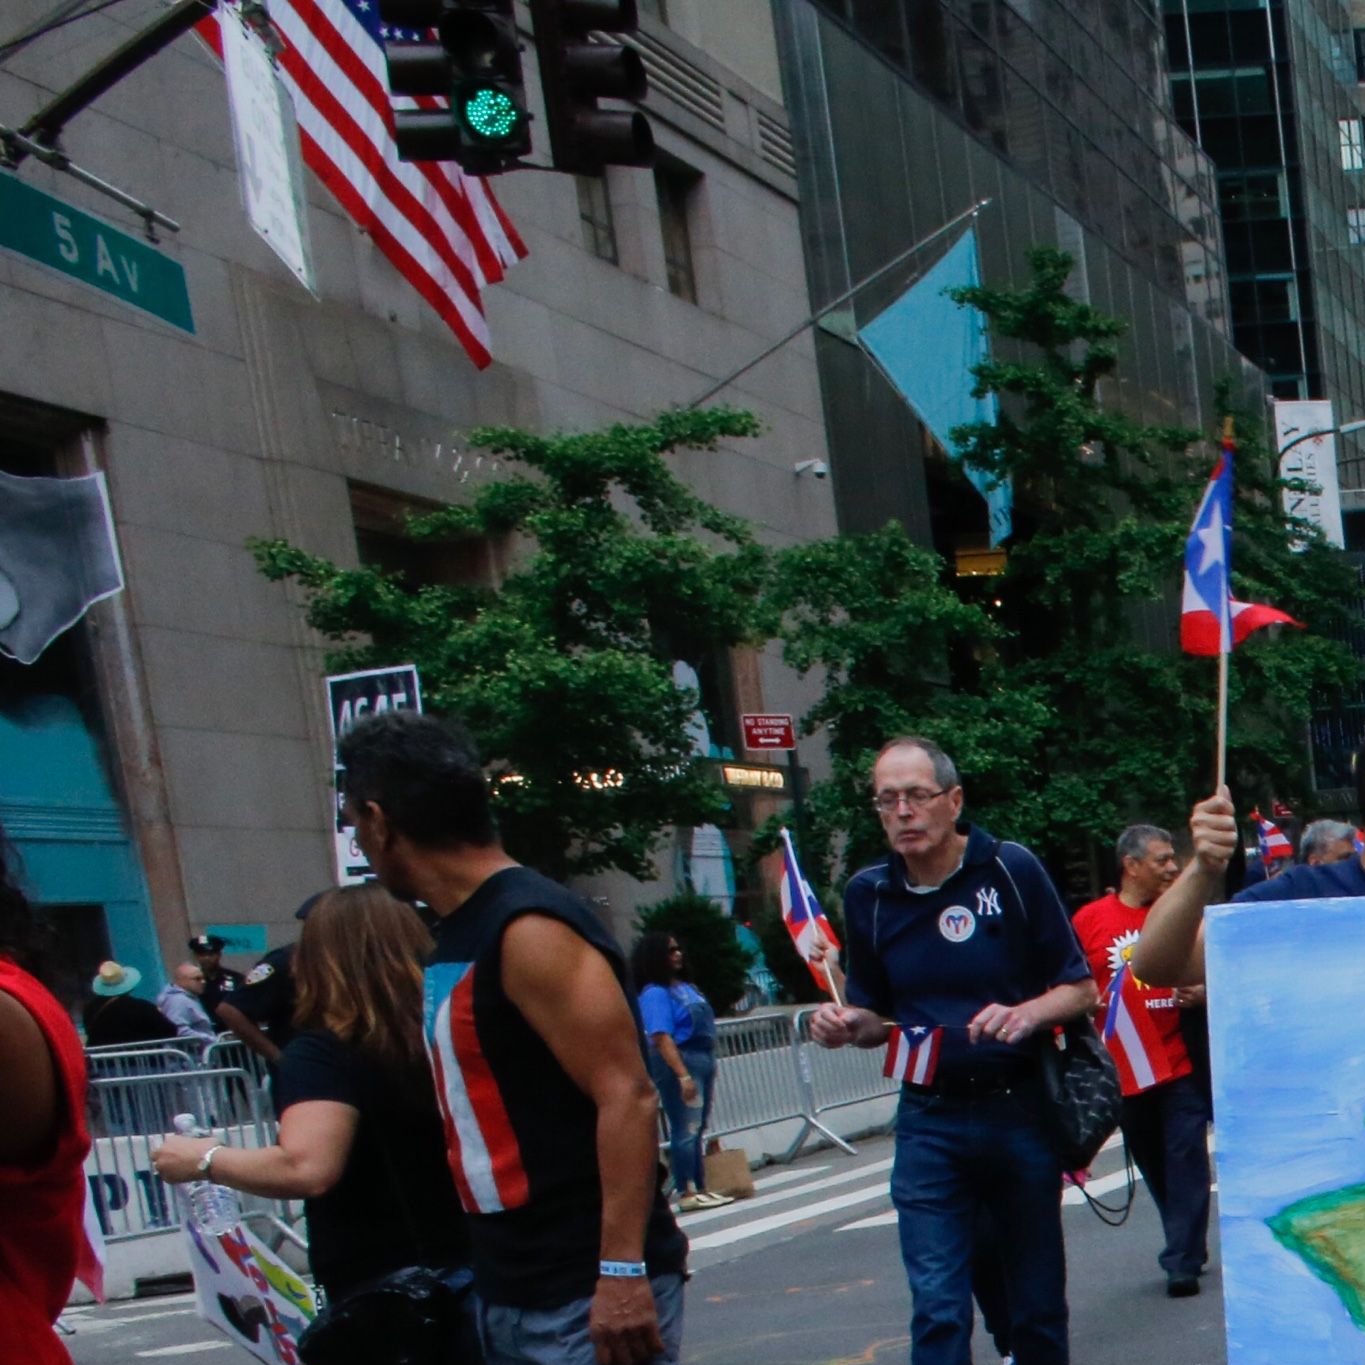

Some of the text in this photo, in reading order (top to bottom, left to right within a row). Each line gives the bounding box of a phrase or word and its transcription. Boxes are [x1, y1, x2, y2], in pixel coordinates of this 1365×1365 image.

[53, 211, 80, 265] 5
[745, 717, 789, 727] NO STANDING
[976, 888, 1002, 915] NY
[1144, 998, 1174, 1009] HERE
